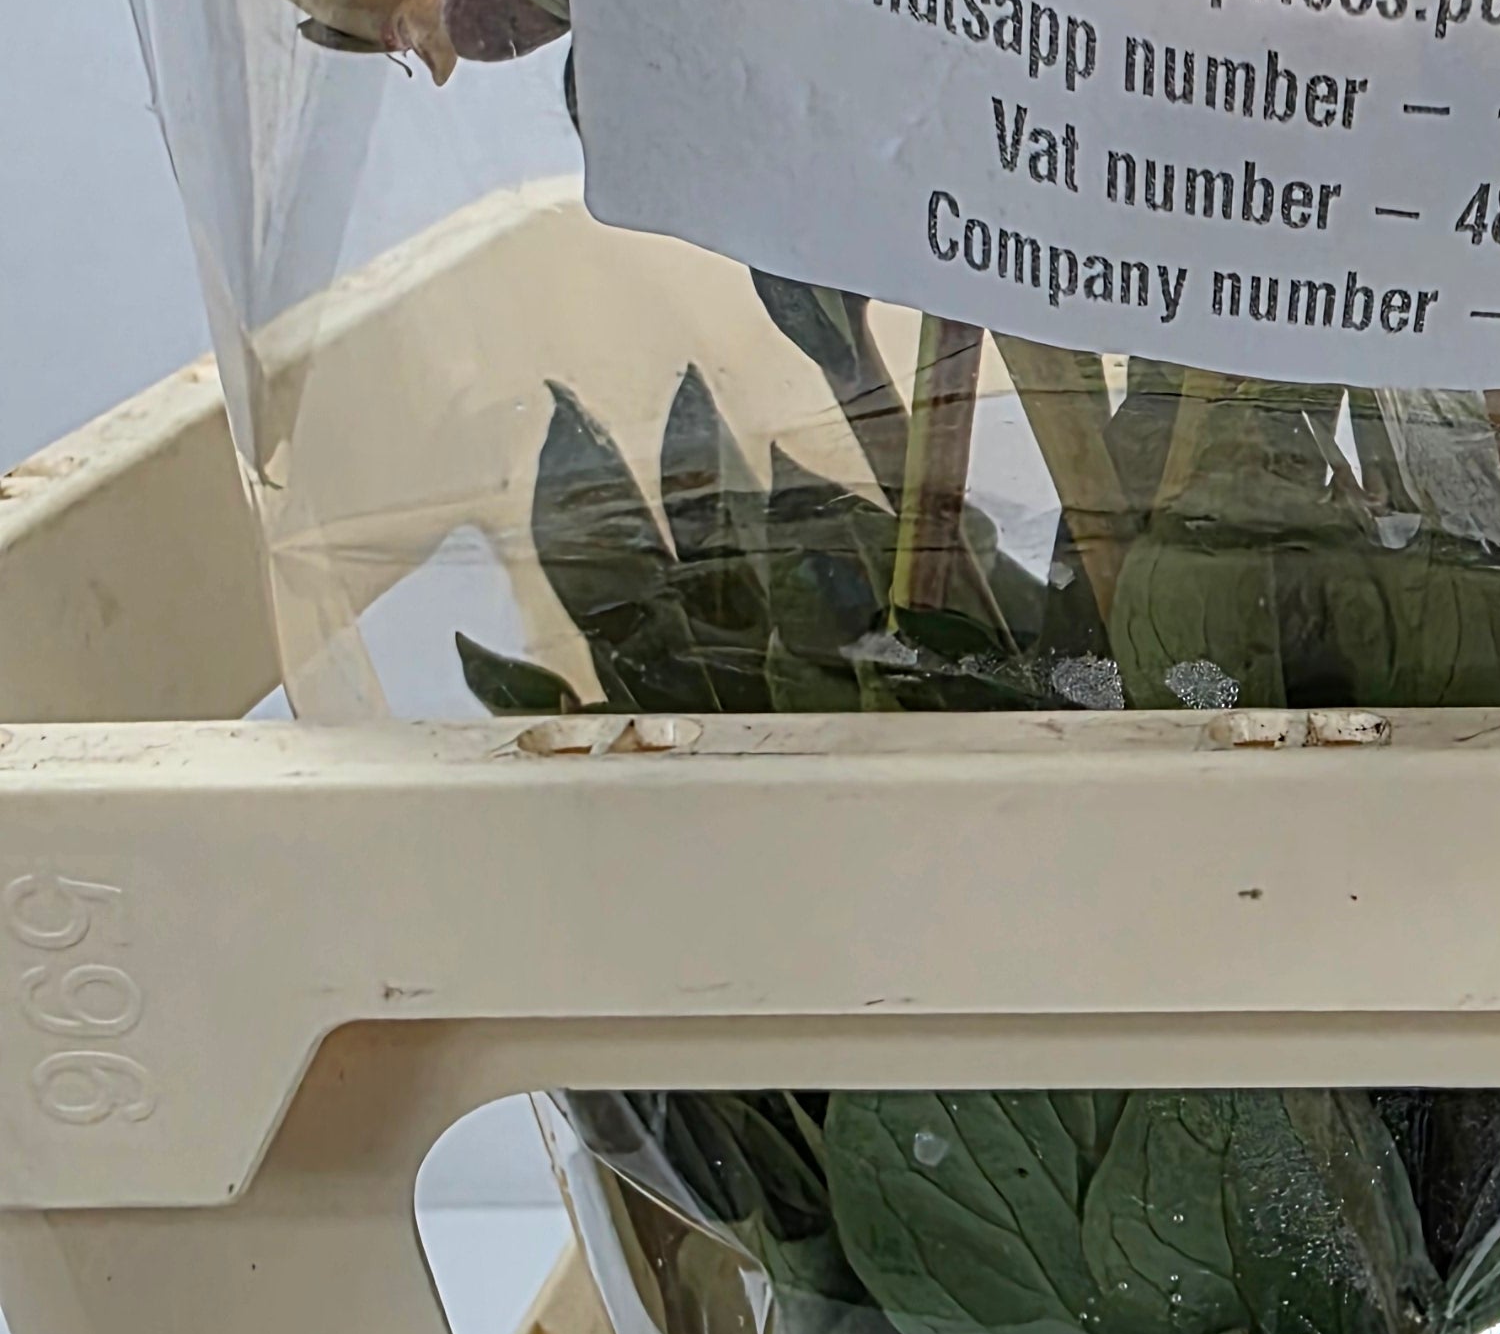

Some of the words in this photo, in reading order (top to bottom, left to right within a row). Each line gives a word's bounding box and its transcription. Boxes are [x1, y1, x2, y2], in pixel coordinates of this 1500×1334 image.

[1125, 33, 1369, 129] number
[994, 96, 1080, 193] Vat
[1108, 146, 1341, 231] number
[926, 191, 1187, 324] Company
[1213, 269, 1439, 333] number
